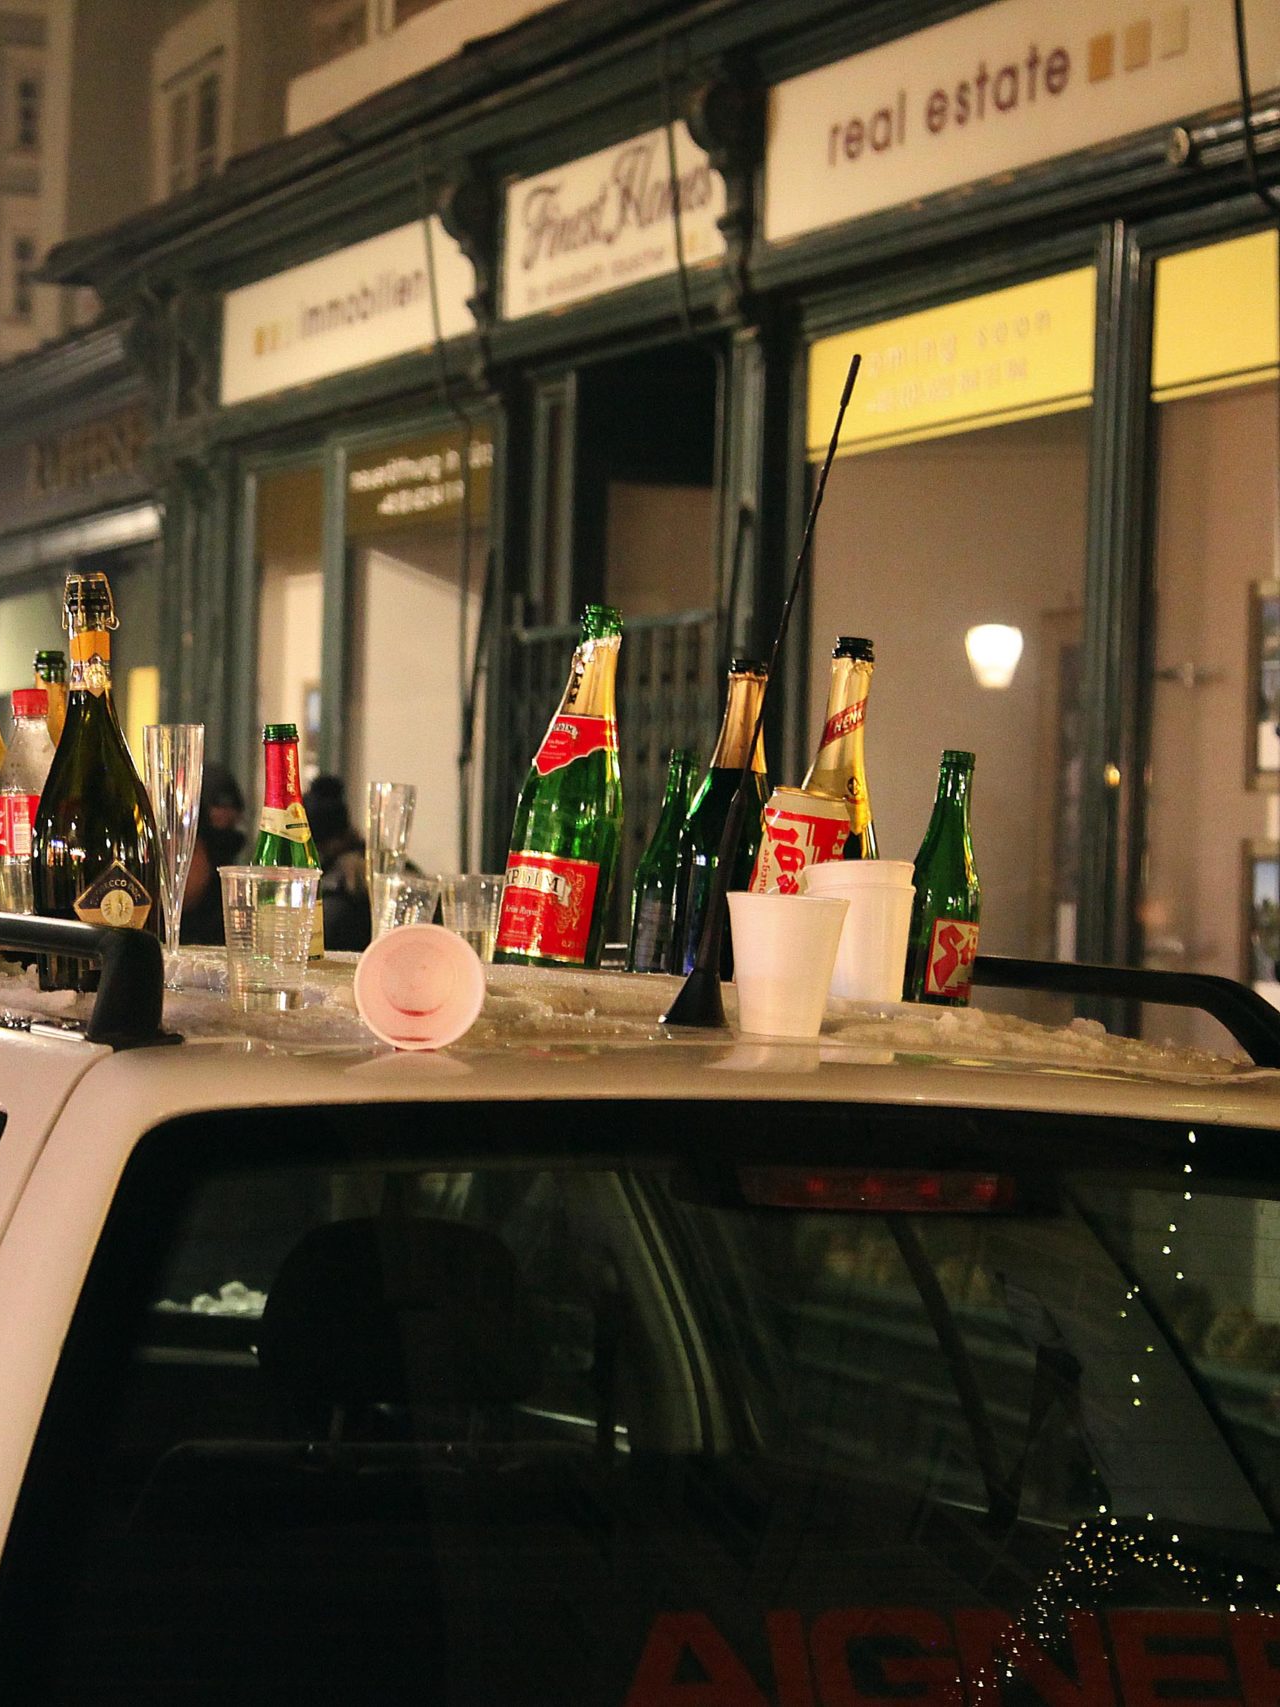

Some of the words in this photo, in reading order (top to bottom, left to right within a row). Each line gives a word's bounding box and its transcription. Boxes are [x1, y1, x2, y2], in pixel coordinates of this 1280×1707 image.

[827, 89, 908, 167] real
[924, 43, 1072, 136] estate
[300, 263, 426, 330] immobilien
[865, 334, 960, 378] oming
[833, 709, 865, 734] HENK
